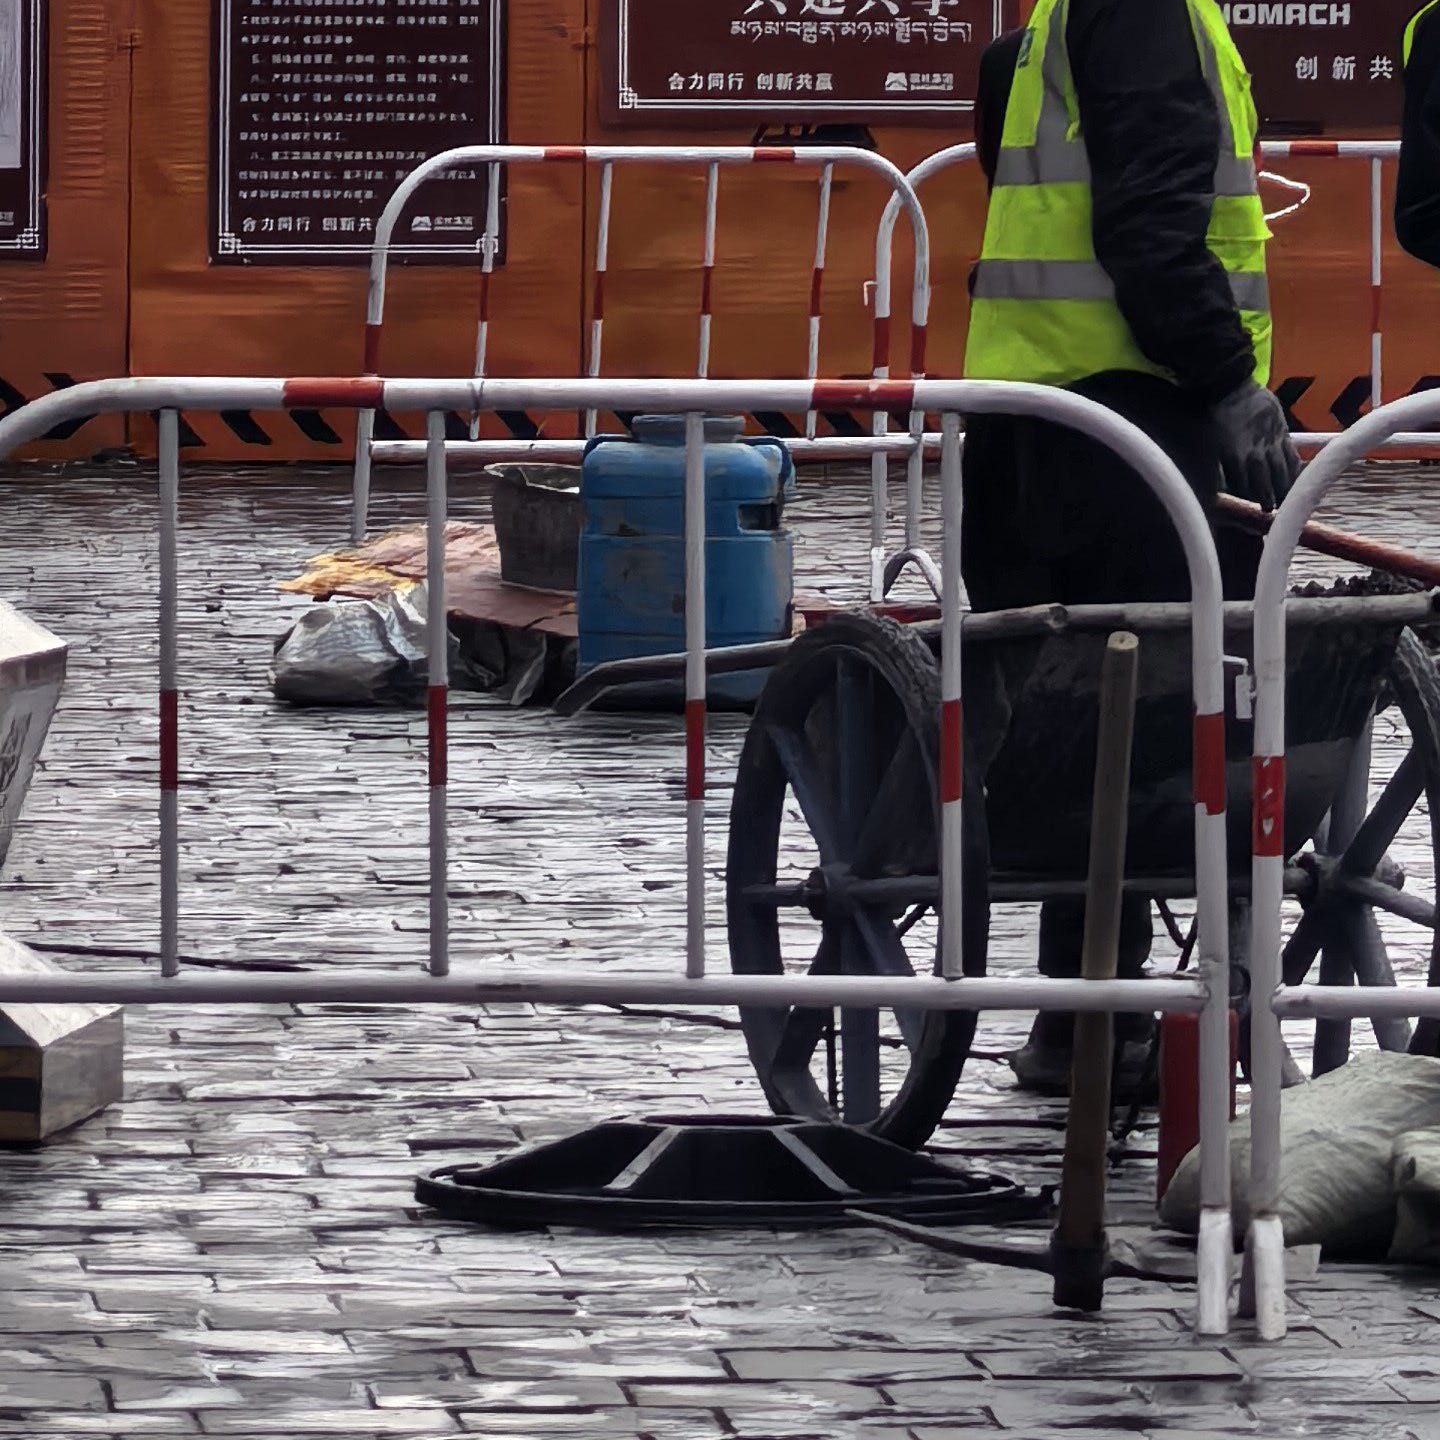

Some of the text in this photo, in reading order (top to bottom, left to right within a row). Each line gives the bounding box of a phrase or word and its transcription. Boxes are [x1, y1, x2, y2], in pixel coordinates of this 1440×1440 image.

[668, 72, 833, 91] 合力同行 创新共赢
[242, 217, 310, 232] 合力同行
